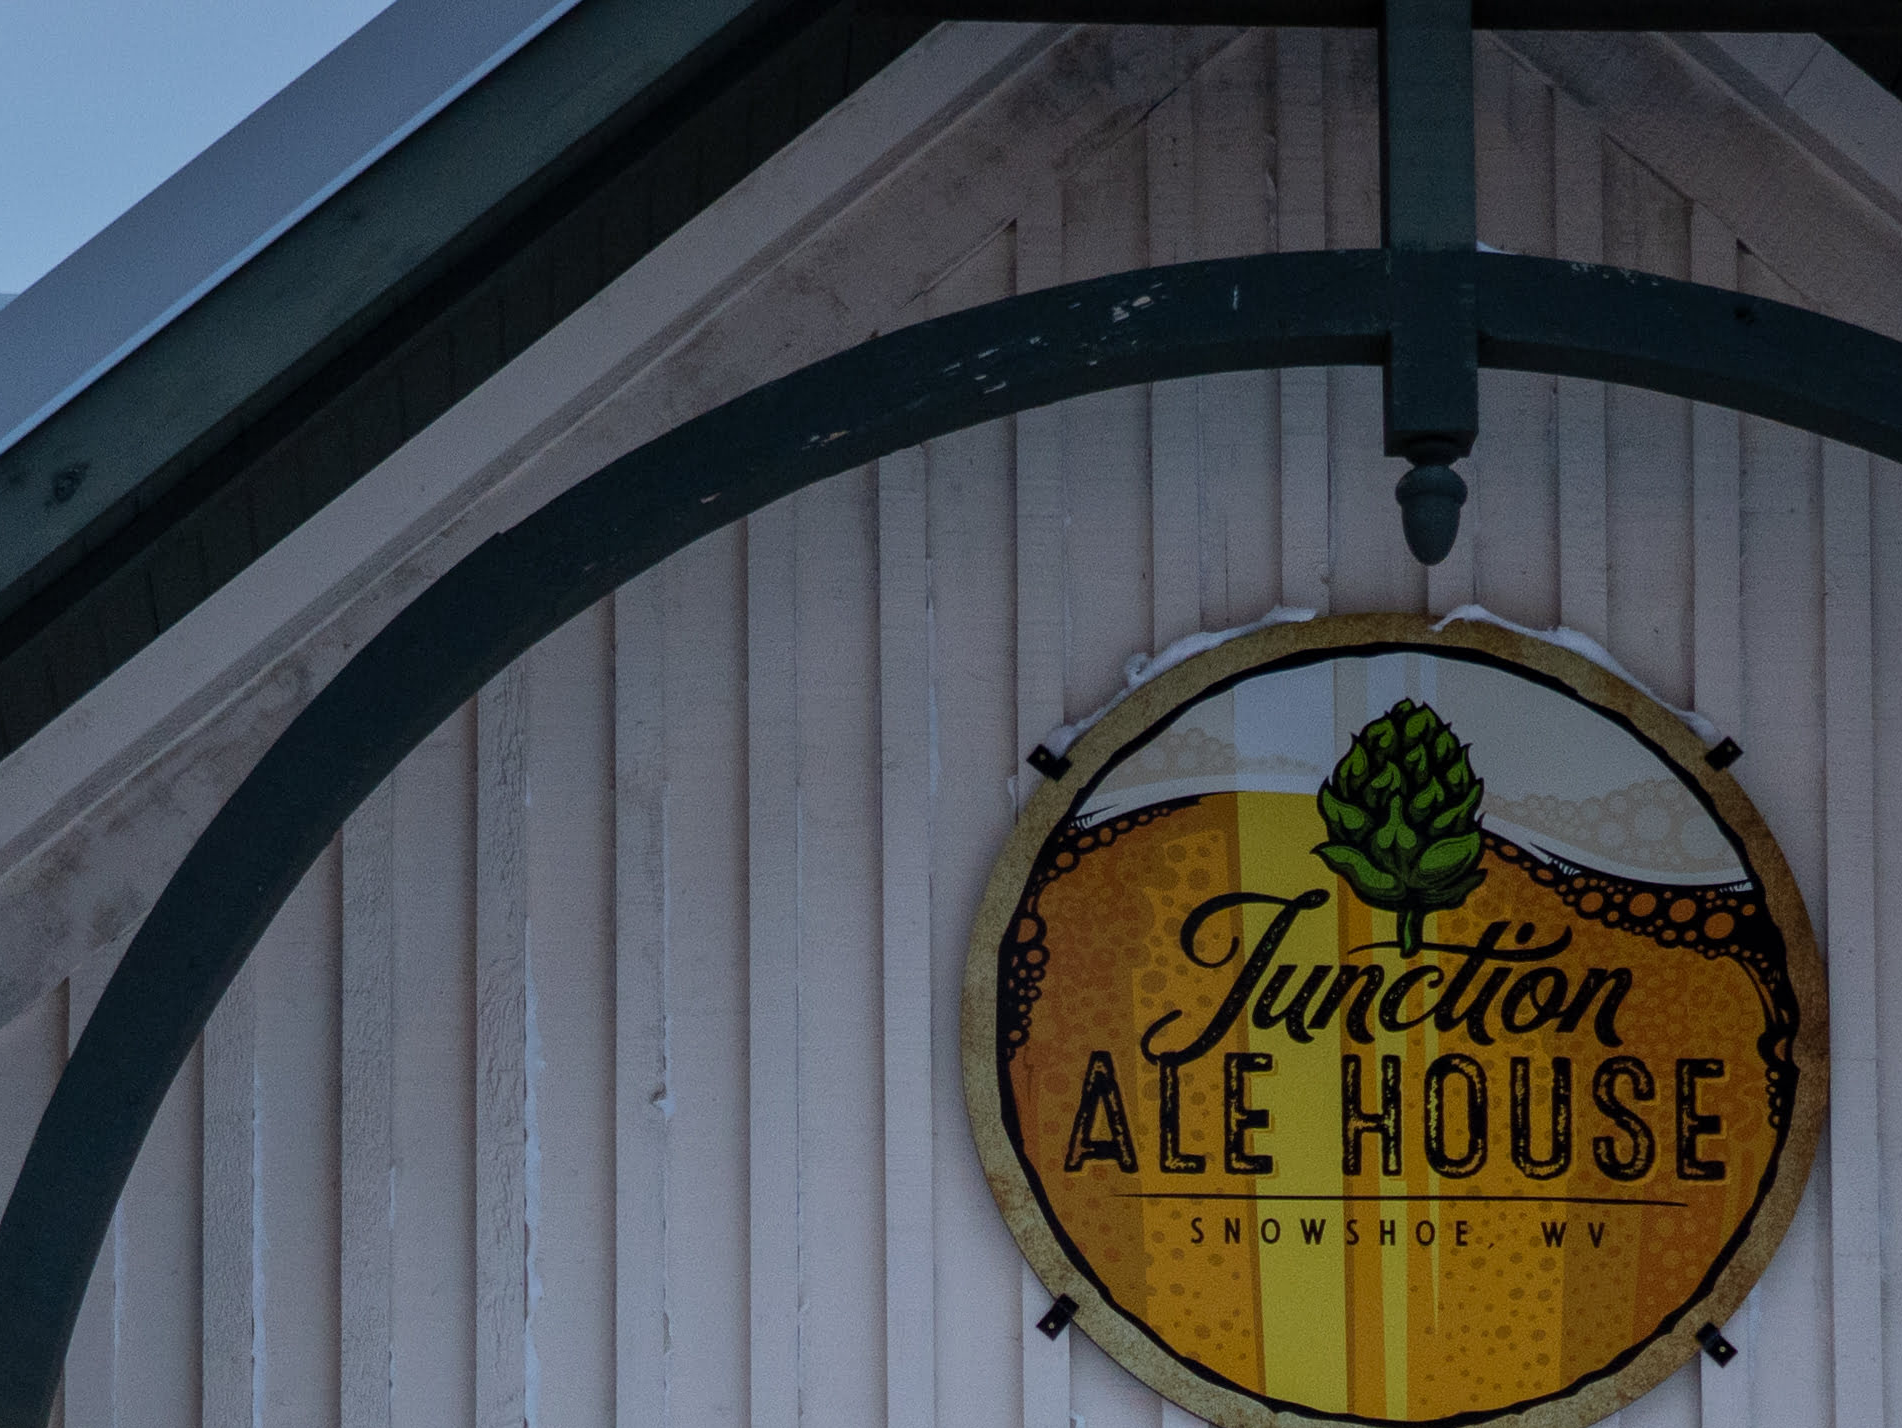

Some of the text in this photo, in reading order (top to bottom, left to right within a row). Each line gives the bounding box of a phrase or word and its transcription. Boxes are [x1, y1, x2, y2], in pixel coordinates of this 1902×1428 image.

[1141, 889, 1633, 1068] Junction
[1063, 1050, 1727, 1182] ALE HOUSE
[1190, 1216, 1606, 1249] SNOWSHOE, WV
